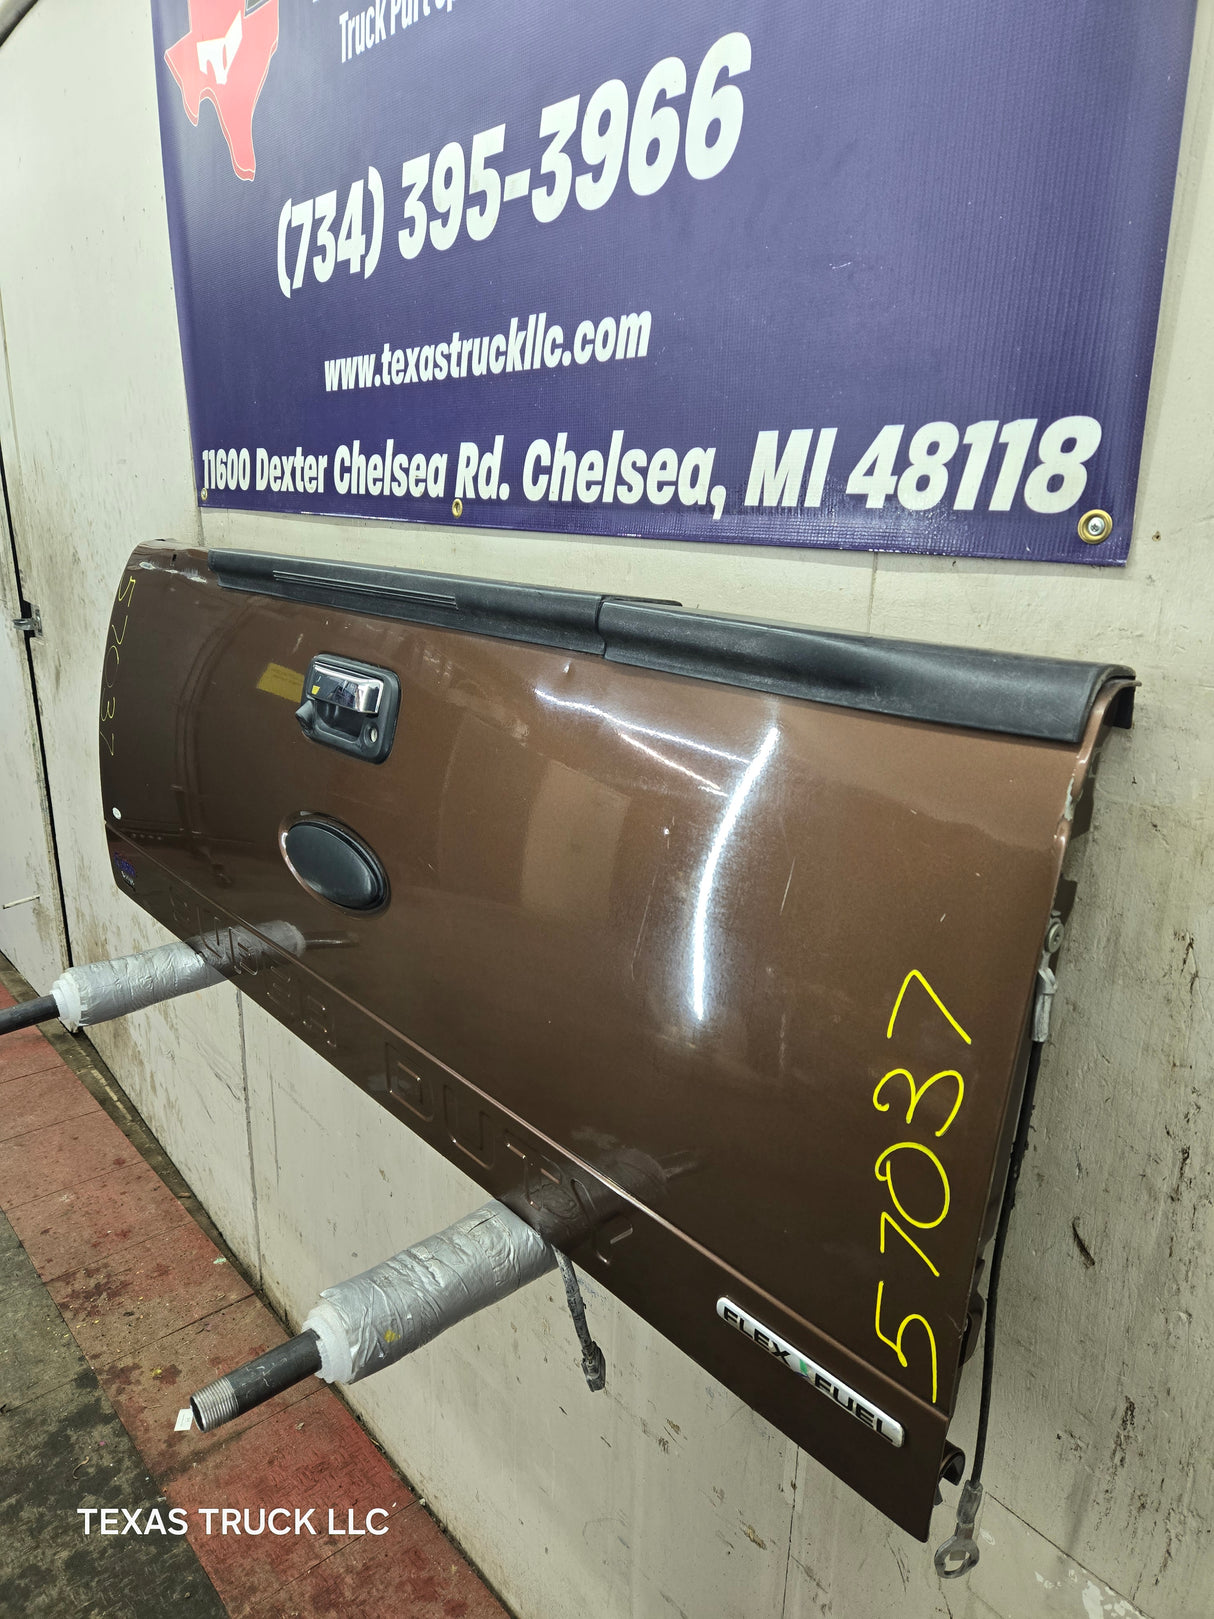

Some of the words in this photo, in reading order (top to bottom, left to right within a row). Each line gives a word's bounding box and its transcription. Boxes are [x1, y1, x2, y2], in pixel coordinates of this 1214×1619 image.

[339, 0, 387, 63] Truck
[277, 166, 385, 299] (734)
[398, 32, 752, 260] 395-3966
[324, 310, 652, 392] www.texastruckllc.com
[202, 447, 251, 491] 11600
[256, 446, 328, 493] Dexter
[333, 438, 448, 498] Chelsea
[454, 434, 510, 501] Rd.
[522, 429, 727, 521] Chelsea,
[744, 427, 838, 508] MI
[845, 415, 1102, 514] 48118
[384, 1042, 635, 1265] DUTY
[873, 969, 972, 1404] 57037
[724, 1306, 791, 1366] FLEX
[815, 1373, 894, 1443] FUEL
